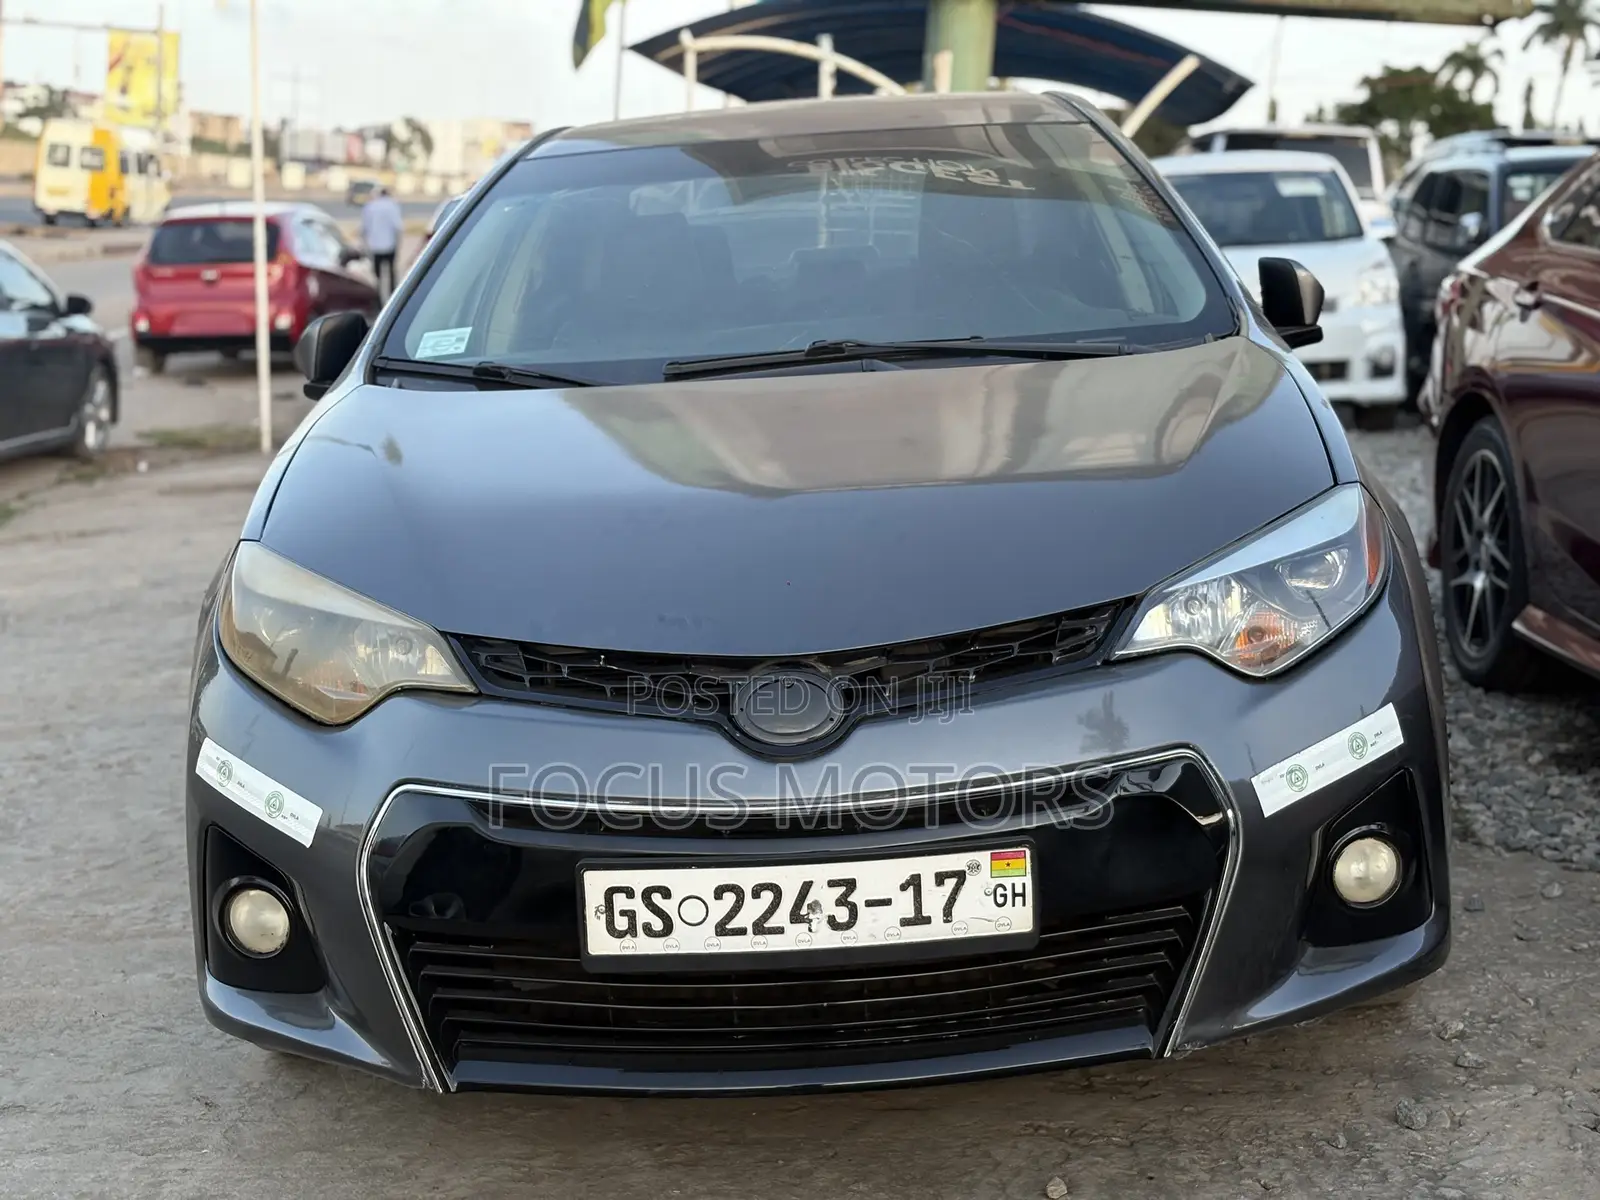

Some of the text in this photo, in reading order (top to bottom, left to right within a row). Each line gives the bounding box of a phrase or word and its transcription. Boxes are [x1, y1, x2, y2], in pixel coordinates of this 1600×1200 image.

[604, 869, 967, 938] GS 2243-17
[993, 882, 1027, 908] GH
